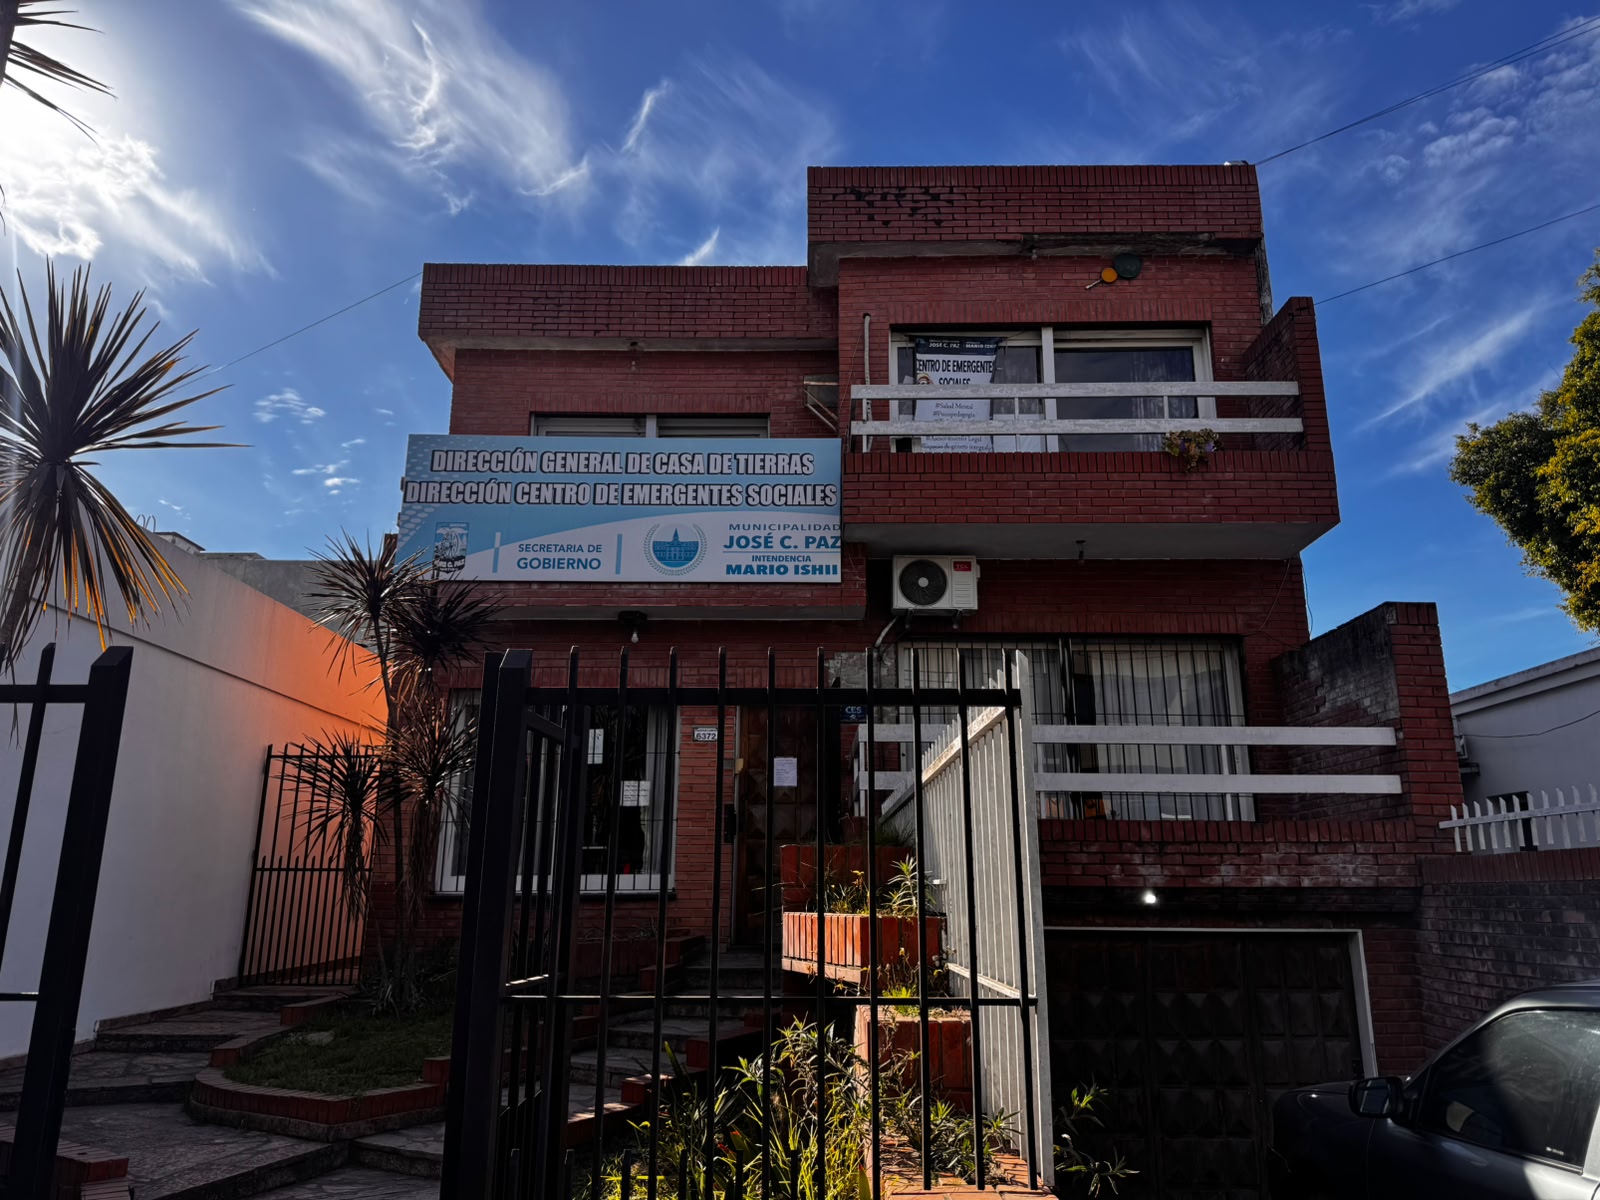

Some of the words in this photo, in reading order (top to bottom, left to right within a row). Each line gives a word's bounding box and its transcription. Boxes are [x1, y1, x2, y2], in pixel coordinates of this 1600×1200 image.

[942, 360, 951, 372] DE
[953, 361, 994, 373] EMERGENTE
[431, 447, 538, 473] DIRECCIÓN
[540, 451, 623, 474] GENERAL
[626, 452, 651, 474] DE
[653, 452, 705, 475] CASA
[707, 453, 733, 475] DE
[734, 453, 815, 475] TIERRAS
[404, 478, 512, 504] DIRECCIÓN
[514, 482, 592, 505] CENTRO
[593, 482, 619, 505] DE
[621, 483, 745, 506] EMERGENTES
[746, 484, 838, 506] SOCIALES
[729, 523, 841, 531] MUNICIPALIDAD
[723, 532, 774, 549] JOSÉ
[779, 535, 798, 549] C.
[804, 535, 841, 549] PAZ
[518, 543, 584, 553] SECRETARIA
[587, 544, 602, 553] DE
[517, 557, 601, 570] GOBIERNO
[751, 555, 812, 563] INTENDENCIA
[726, 564, 789, 575] MARIO
[793, 564, 838, 575] ISHII
[845, 706, 862, 714] CES
